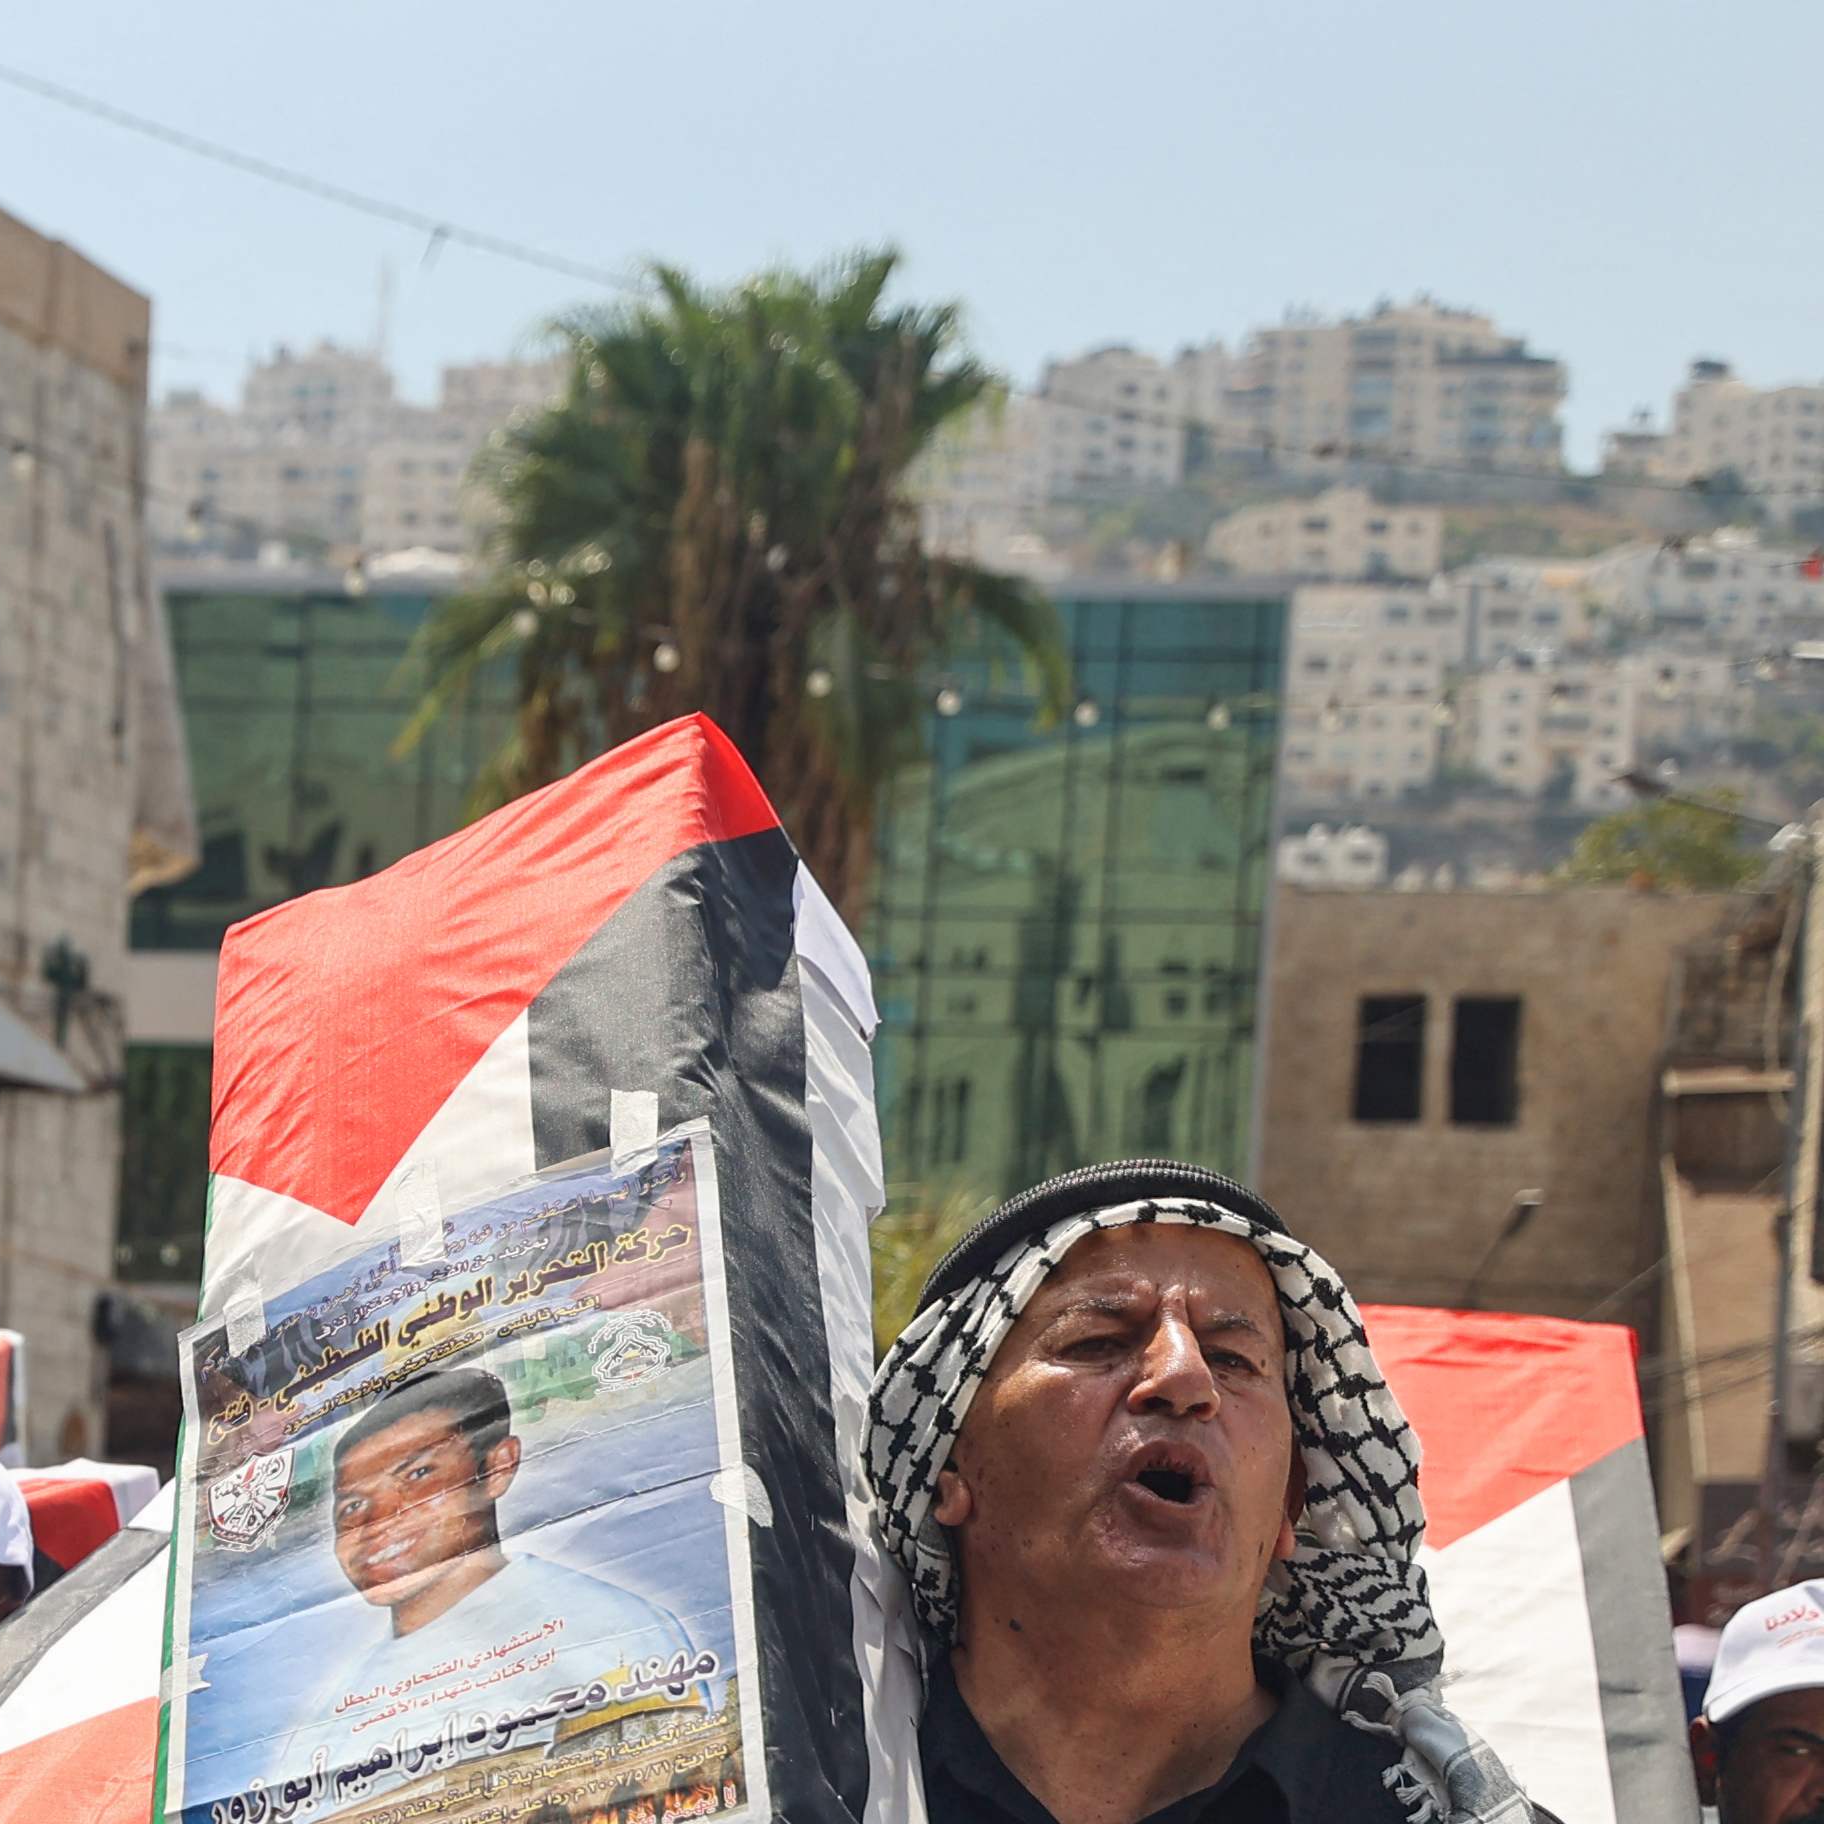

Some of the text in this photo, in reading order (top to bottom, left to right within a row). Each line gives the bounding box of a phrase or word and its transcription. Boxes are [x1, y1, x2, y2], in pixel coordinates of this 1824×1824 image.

[501, 1242, 609, 1306] التحرير
[613, 1223, 692, 1263] حركة
[397, 1275, 495, 1348] الوطني
[273, 1315, 391, 1414] الفلسطيني
[207, 1393, 254, 1445] فتح
[619, 1649, 718, 1698] مهند
[465, 1681, 608, 1750] محمود
[276, 1745, 329, 1819] أبو
[336, 1714, 458, 1804] إبراهيم
